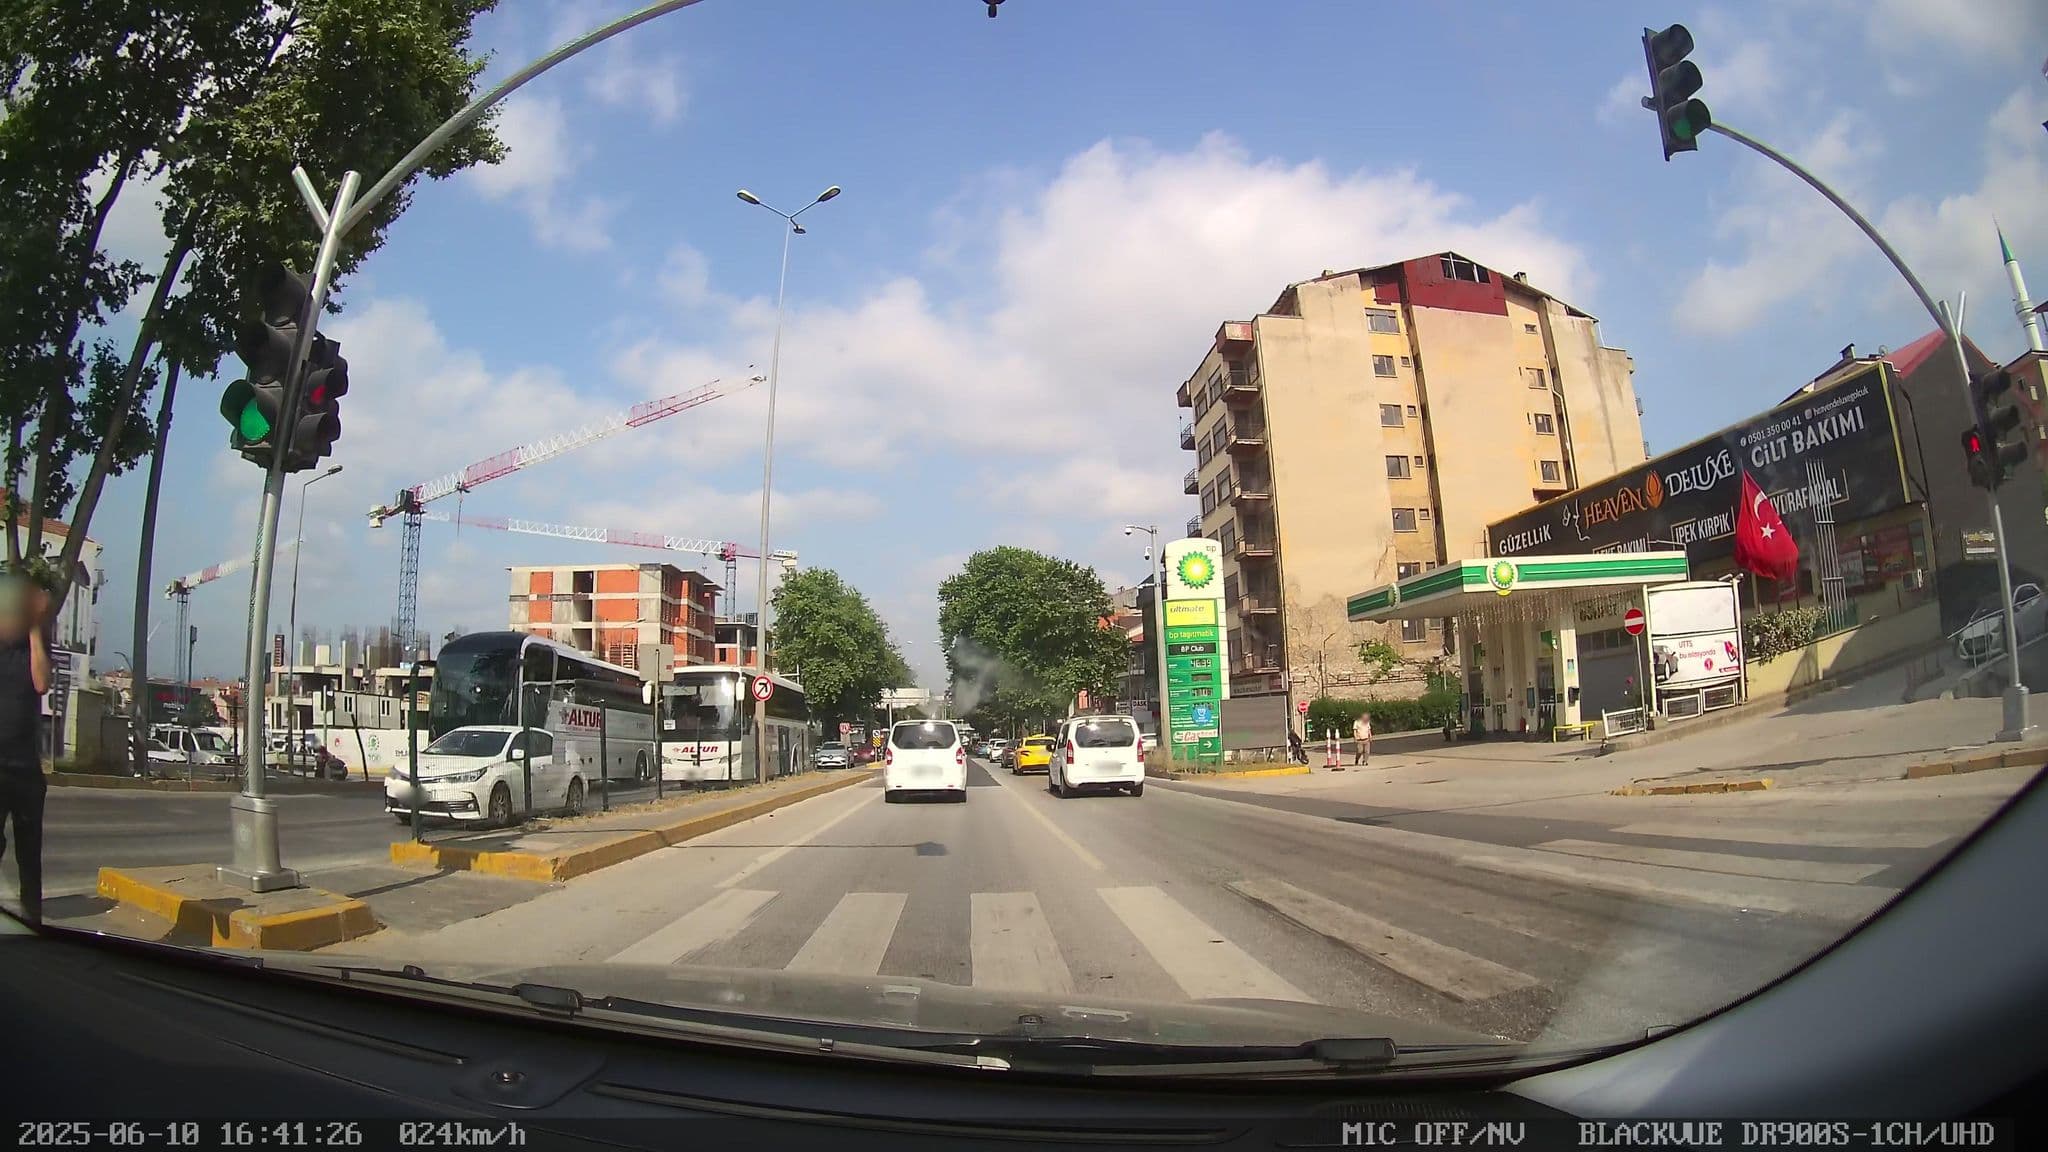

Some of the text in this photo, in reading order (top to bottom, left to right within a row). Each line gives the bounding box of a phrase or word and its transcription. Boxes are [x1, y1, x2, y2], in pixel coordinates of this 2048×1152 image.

[1747, 415, 1802, 444] 0501 350 00 41
[1791, 406, 1865, 454] BAKIMI
[1584, 449, 1735, 529] HEAVEN DELUXE
[1206, 545, 1217, 553] bp
[1499, 523, 1552, 555] GÜZELLİK
[1168, 631, 1179, 639] bp
[1678, 640, 1693, 649] UTTS
